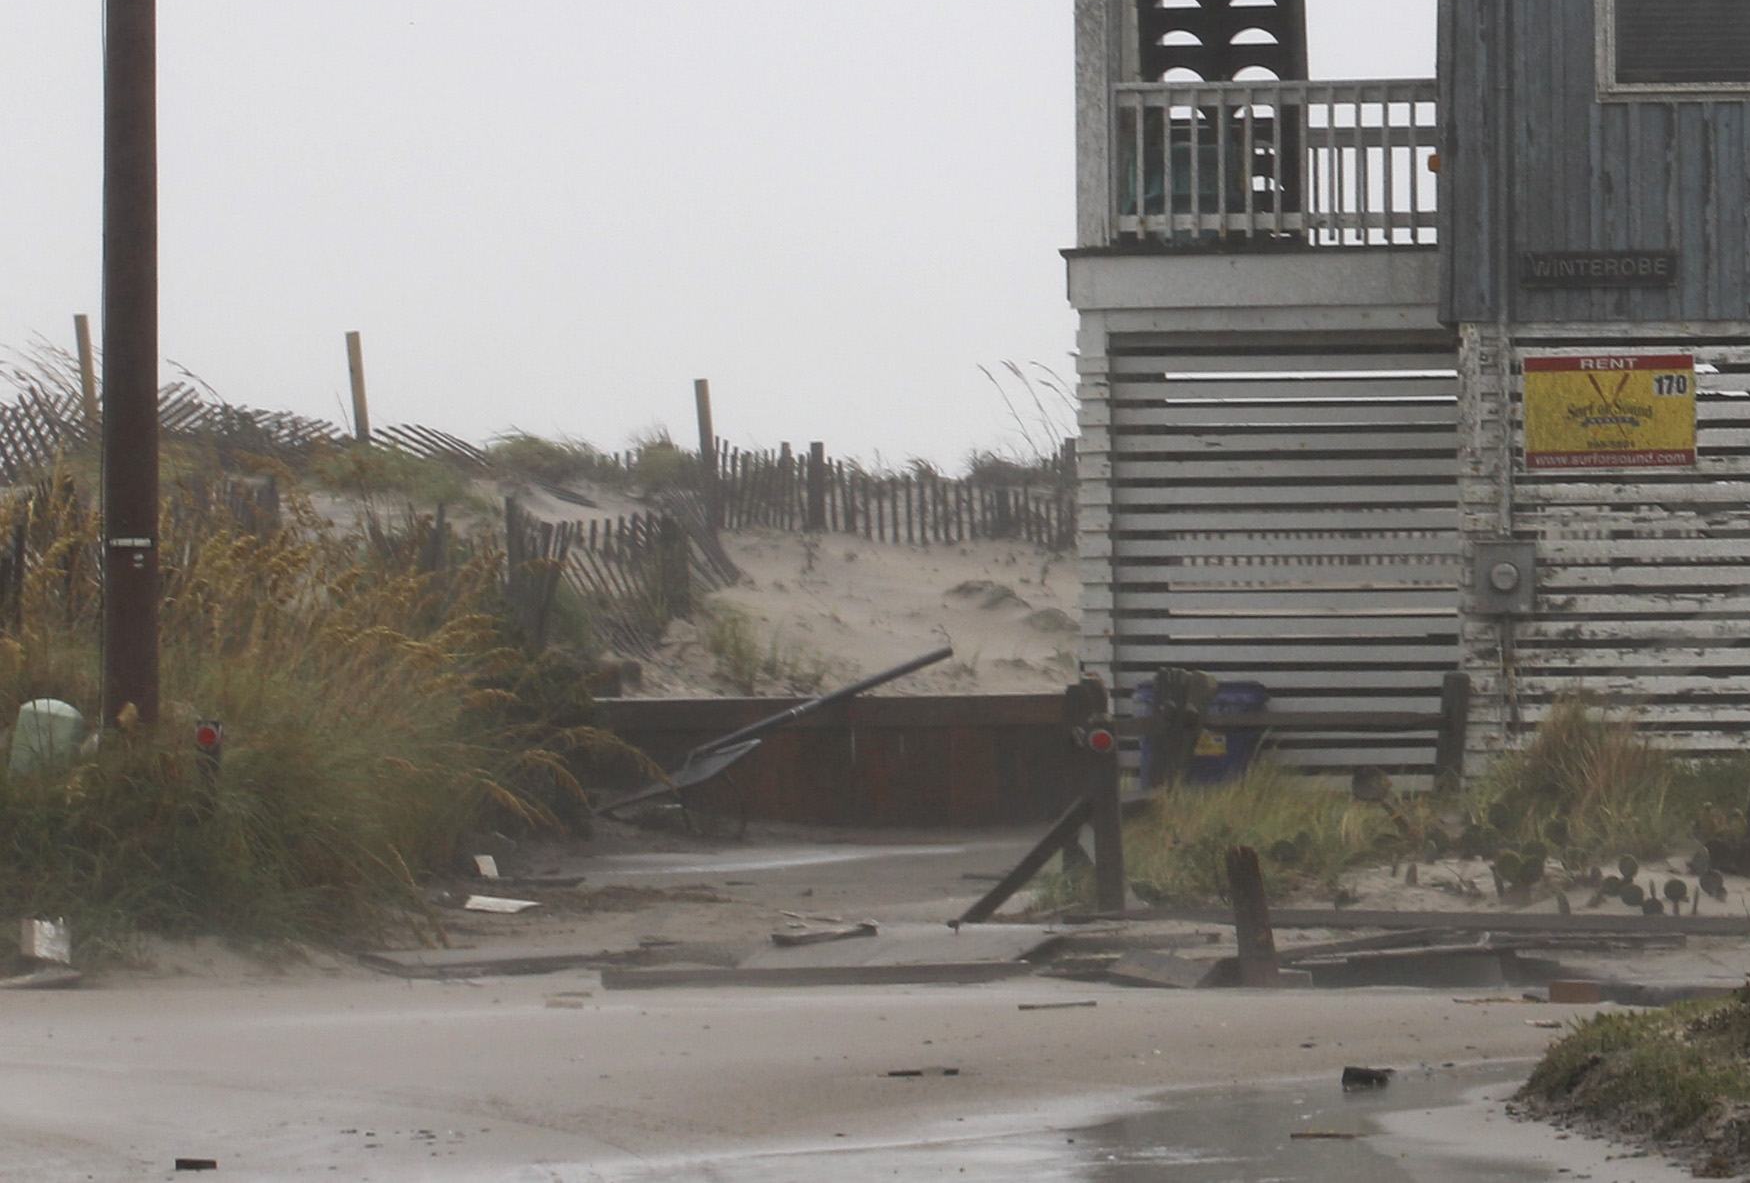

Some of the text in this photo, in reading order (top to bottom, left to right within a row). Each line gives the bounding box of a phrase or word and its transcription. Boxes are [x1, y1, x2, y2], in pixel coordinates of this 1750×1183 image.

[1580, 357, 1638, 370] RENT
[1654, 374, 1688, 396] 170
[1535, 452, 1687, 467] www.surforsound.com
